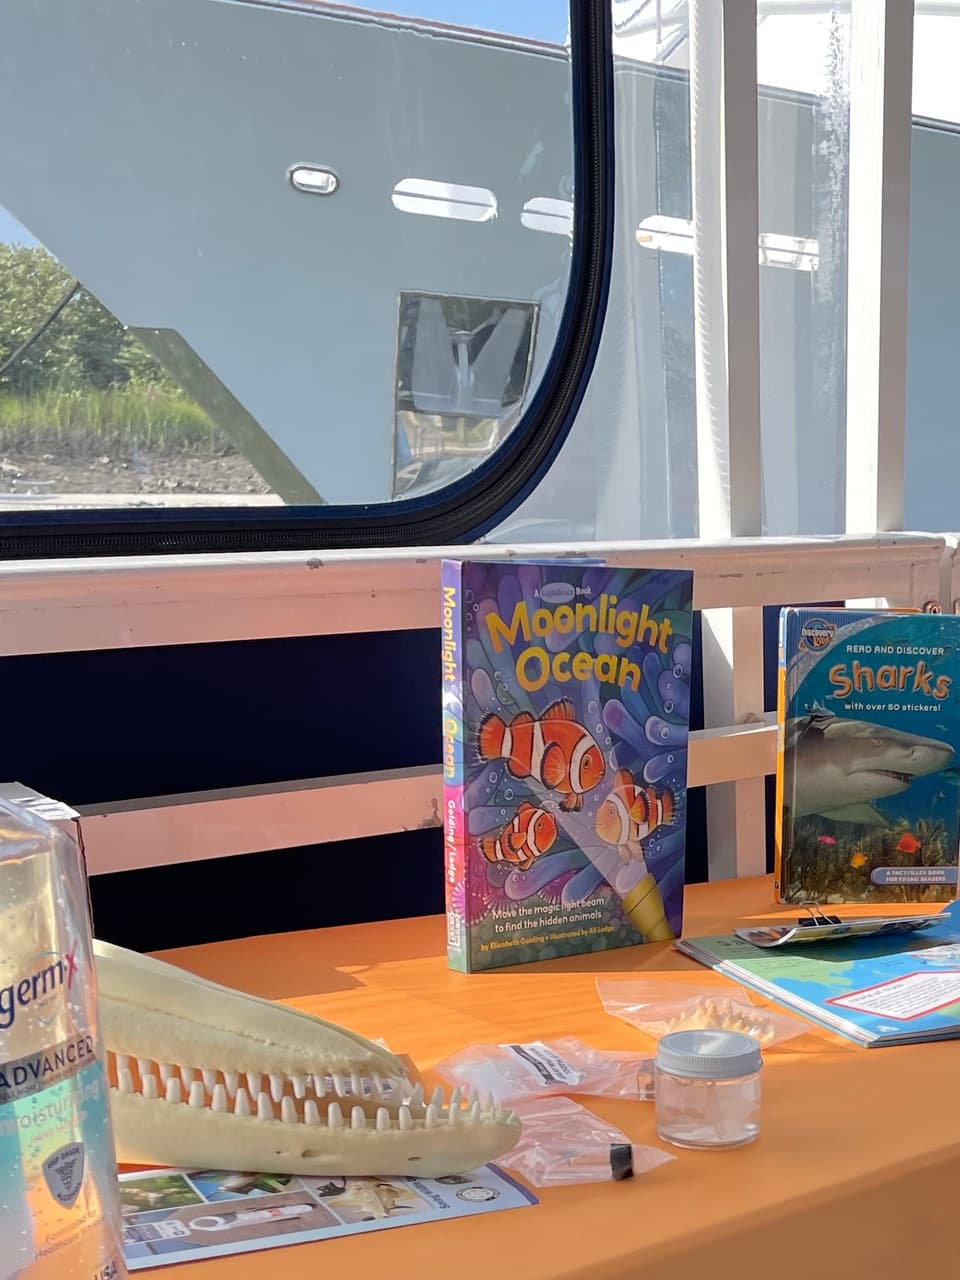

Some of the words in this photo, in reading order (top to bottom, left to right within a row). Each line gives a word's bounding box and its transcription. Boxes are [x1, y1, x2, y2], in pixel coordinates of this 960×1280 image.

[443, 587, 457, 682] Moonlight
[485, 593, 673, 653] Moonlight
[846, 644, 872, 654] READ
[874, 645, 895, 655] AND
[896, 646, 945, 656] DISCOVER
[515, 646, 641, 692] Ocean
[829, 660, 952, 700] Sharks
[845, 703, 864, 711] with
[887, 703, 900, 711] 50
[901, 703, 941, 712] stickers!
[444, 718, 457, 778] Ocean
[492, 909, 517, 920] Move
[519, 906, 533, 916] the
[534, 903, 560, 914] magic
[561, 900, 580, 912] light
[581, 898, 605, 908] beam
[495, 924, 504, 933] to
[505, 921, 523, 932] find
[524, 919, 538, 929] the
[539, 915, 568, 926] hidden
[569, 910, 602, 922] animals
[480, 943, 490, 952] by
[520, 935, 545, 945] Golding
